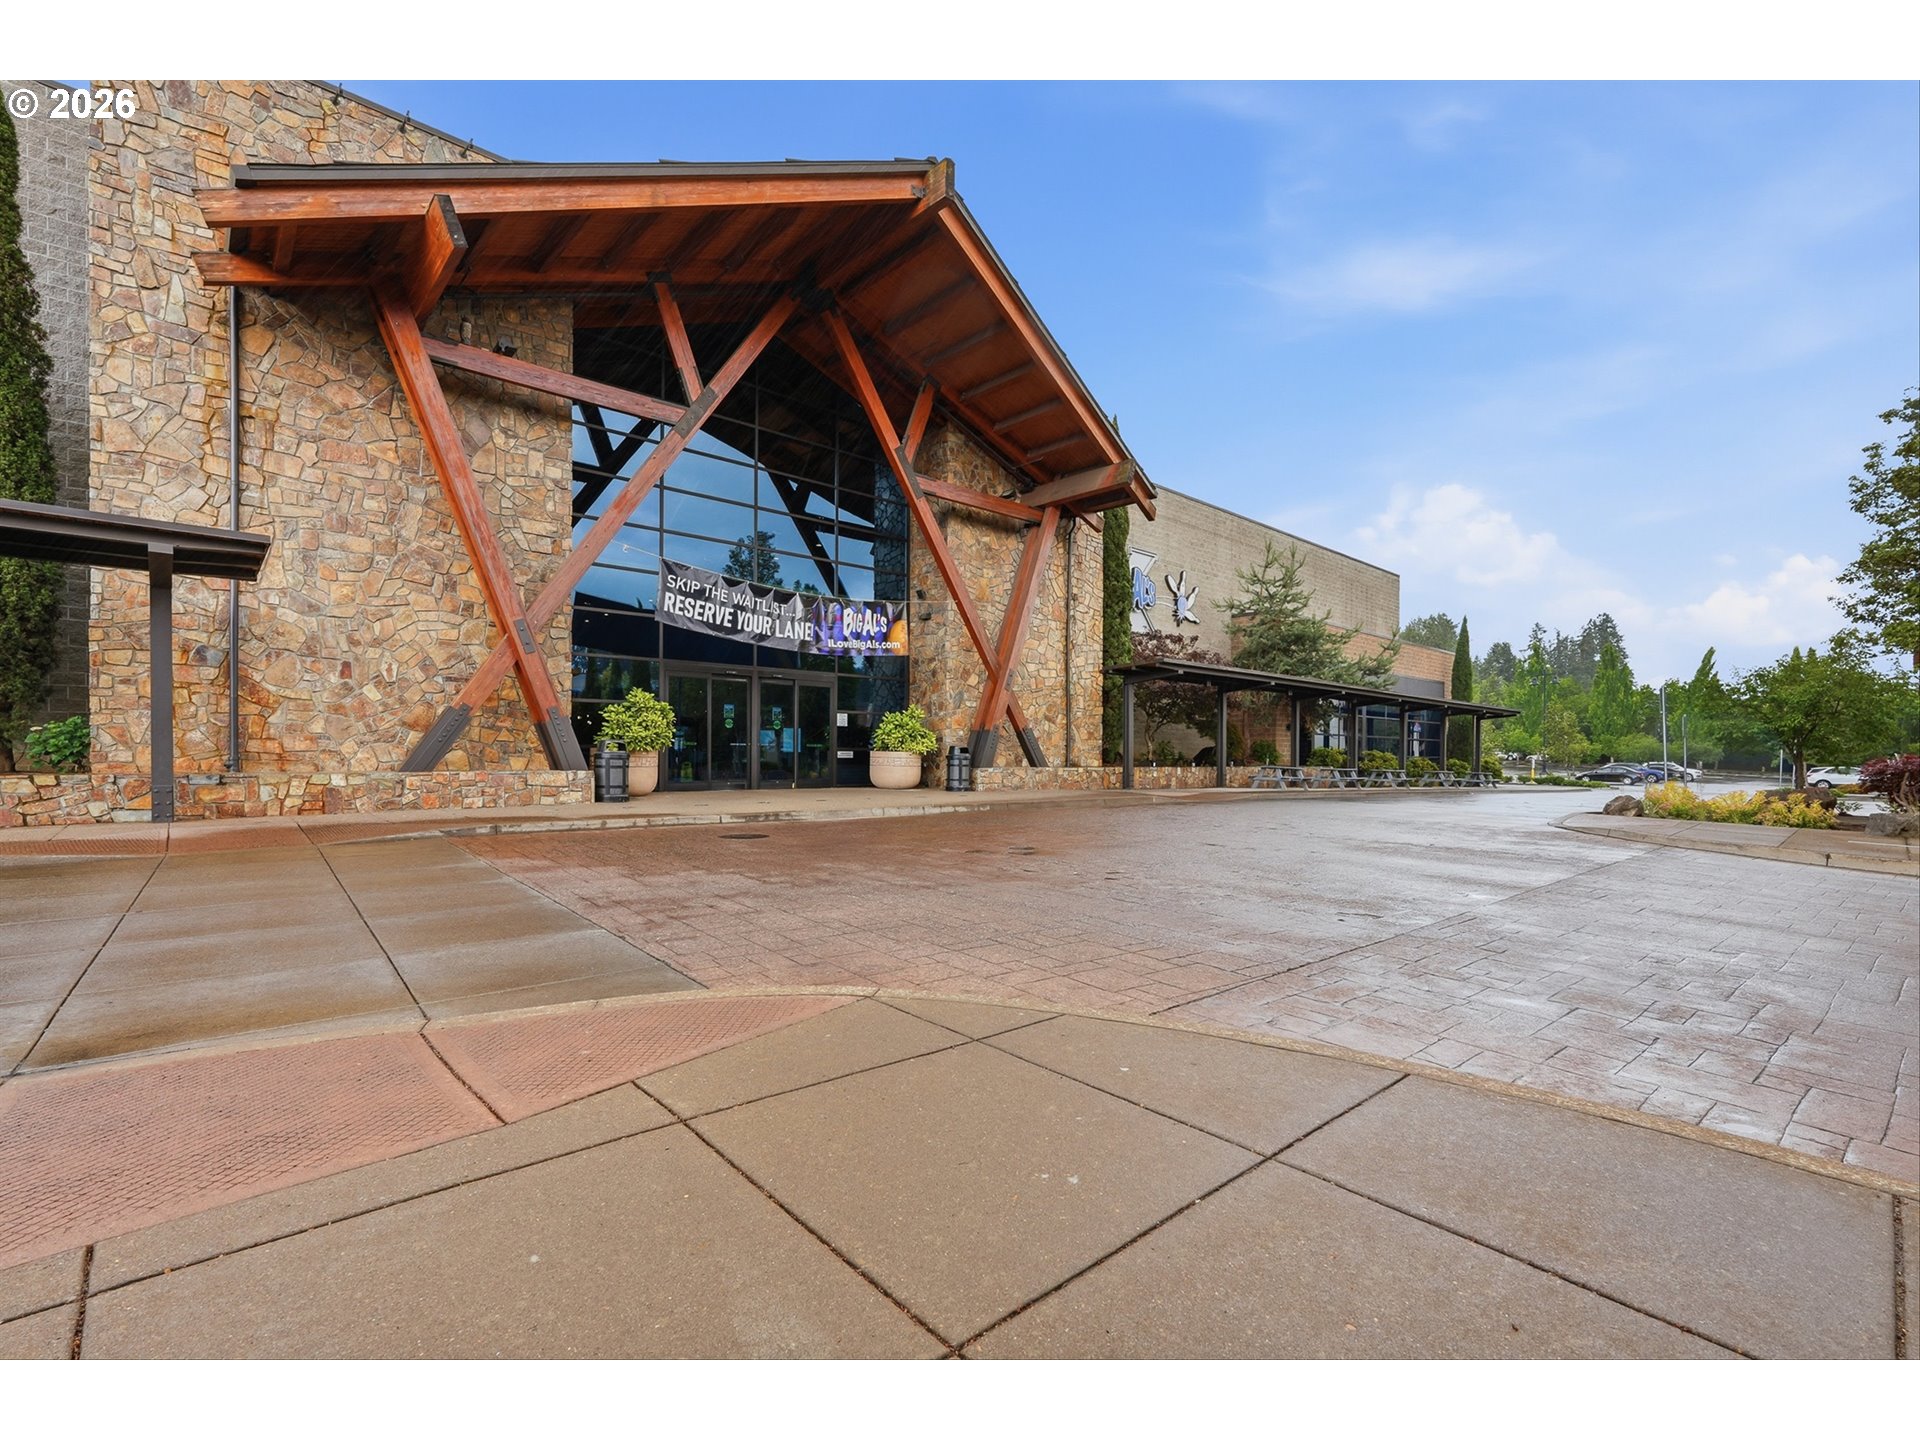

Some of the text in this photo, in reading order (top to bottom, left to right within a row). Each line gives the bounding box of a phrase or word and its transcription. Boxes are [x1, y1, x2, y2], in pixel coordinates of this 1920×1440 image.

[666, 574, 700, 593] SKIP
[703, 584, 729, 602] THE
[663, 591, 813, 641] RESERVE YOUR LANE!
